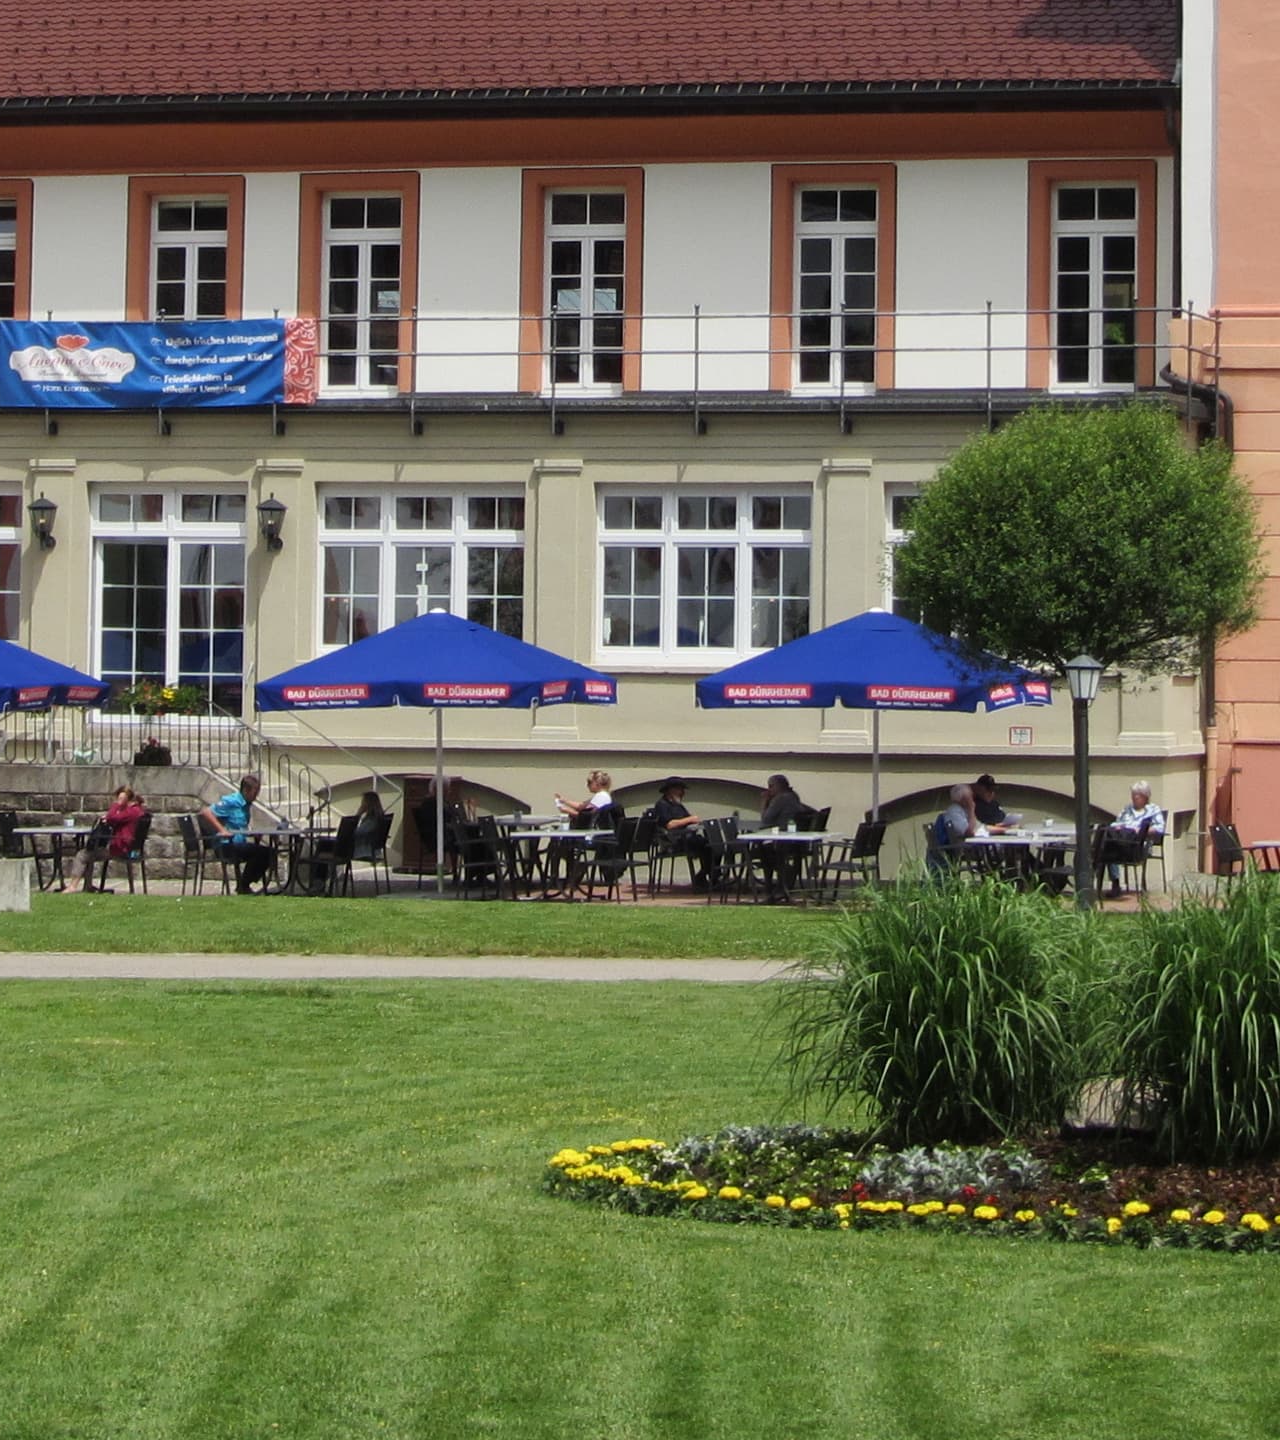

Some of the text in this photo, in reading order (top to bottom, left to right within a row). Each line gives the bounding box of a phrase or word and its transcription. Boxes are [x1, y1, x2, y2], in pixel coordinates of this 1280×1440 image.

[227, 333, 278, 346] Mittagsmenü
[164, 354, 218, 367] durchgehend
[199, 383, 247, 394] Umgebung
[287, 689, 306, 699] BAD
[427, 686, 446, 697] BAD
[728, 687, 747, 697] BAD
[870, 688, 889, 699] BAD
